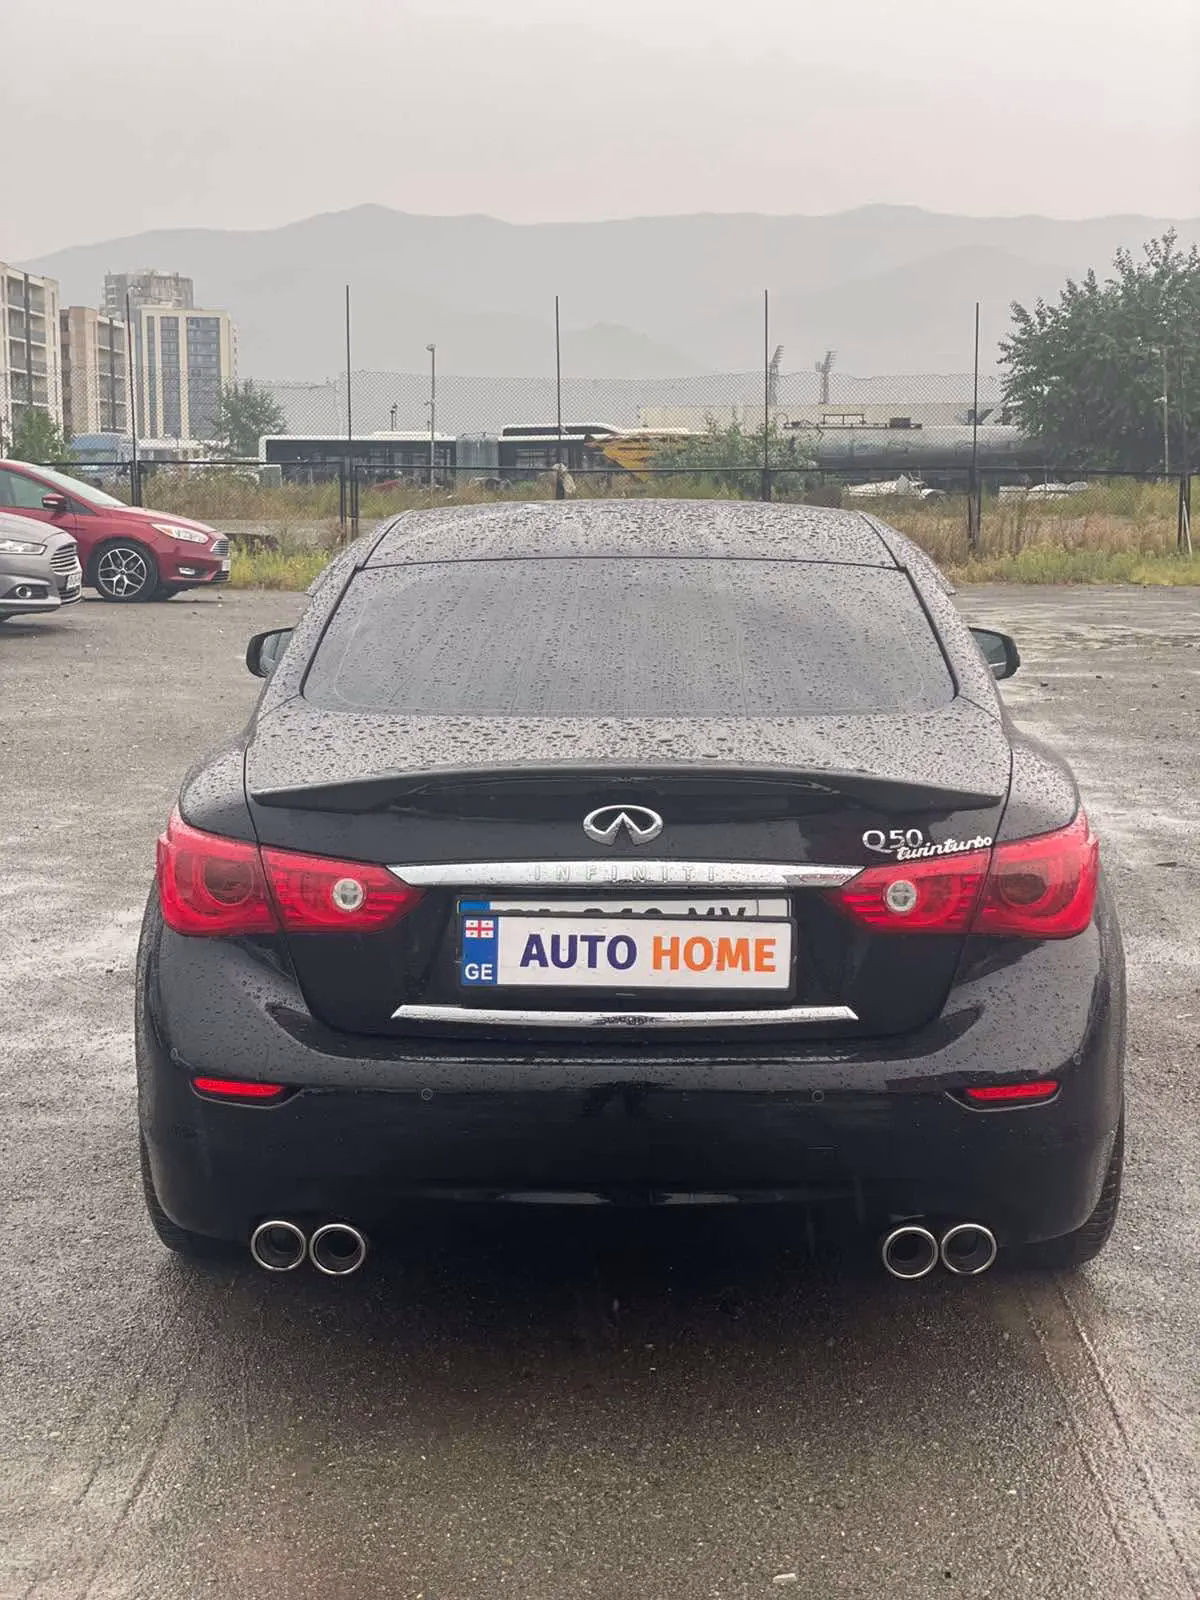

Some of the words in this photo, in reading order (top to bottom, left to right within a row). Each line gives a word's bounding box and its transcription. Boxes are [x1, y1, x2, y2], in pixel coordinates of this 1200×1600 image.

[862, 828, 923, 853] Q50
[896, 835, 993, 860] twinturbo
[534, 864, 717, 883] INFINITI
[519, 933, 638, 969] AUTO
[652, 936, 776, 972] HOME
[464, 963, 493, 981] GE
